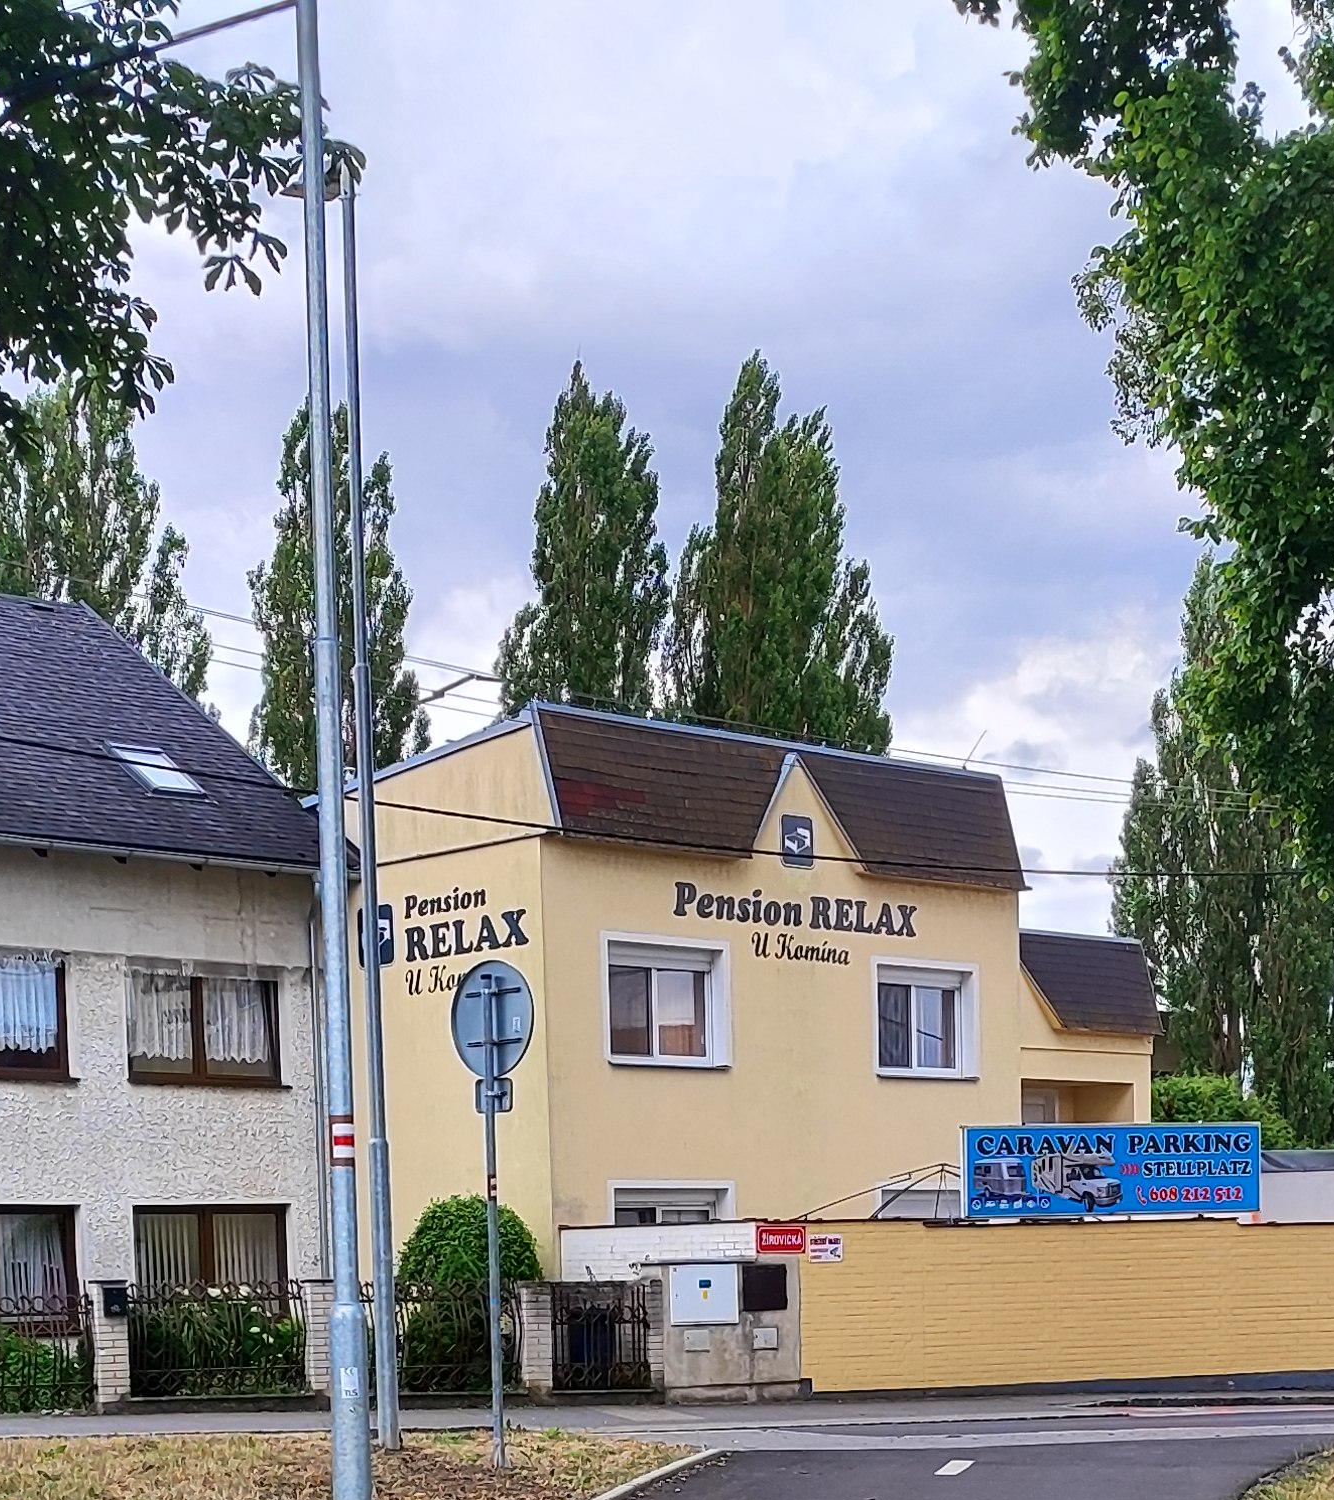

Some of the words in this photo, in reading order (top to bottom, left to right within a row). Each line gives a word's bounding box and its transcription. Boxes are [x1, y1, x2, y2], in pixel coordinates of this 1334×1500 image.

[404, 886, 487, 919] Pension
[673, 881, 803, 927] Pension
[808, 896, 918, 937] RELAX
[404, 908, 530, 962] RELAX
[751, 931, 771, 959] U
[775, 932, 851, 966] Komína
[405, 969, 423, 996] U
[975, 1134, 1116, 1156] CARAVAN
[1127, 1133, 1253, 1154] PARKING
[1142, 1160, 1253, 1177] STELLPLATZ
[1149, 1187, 1178, 1201] 608
[1181, 1187, 1210, 1201] 212
[1213, 1186, 1243, 1200] 512
